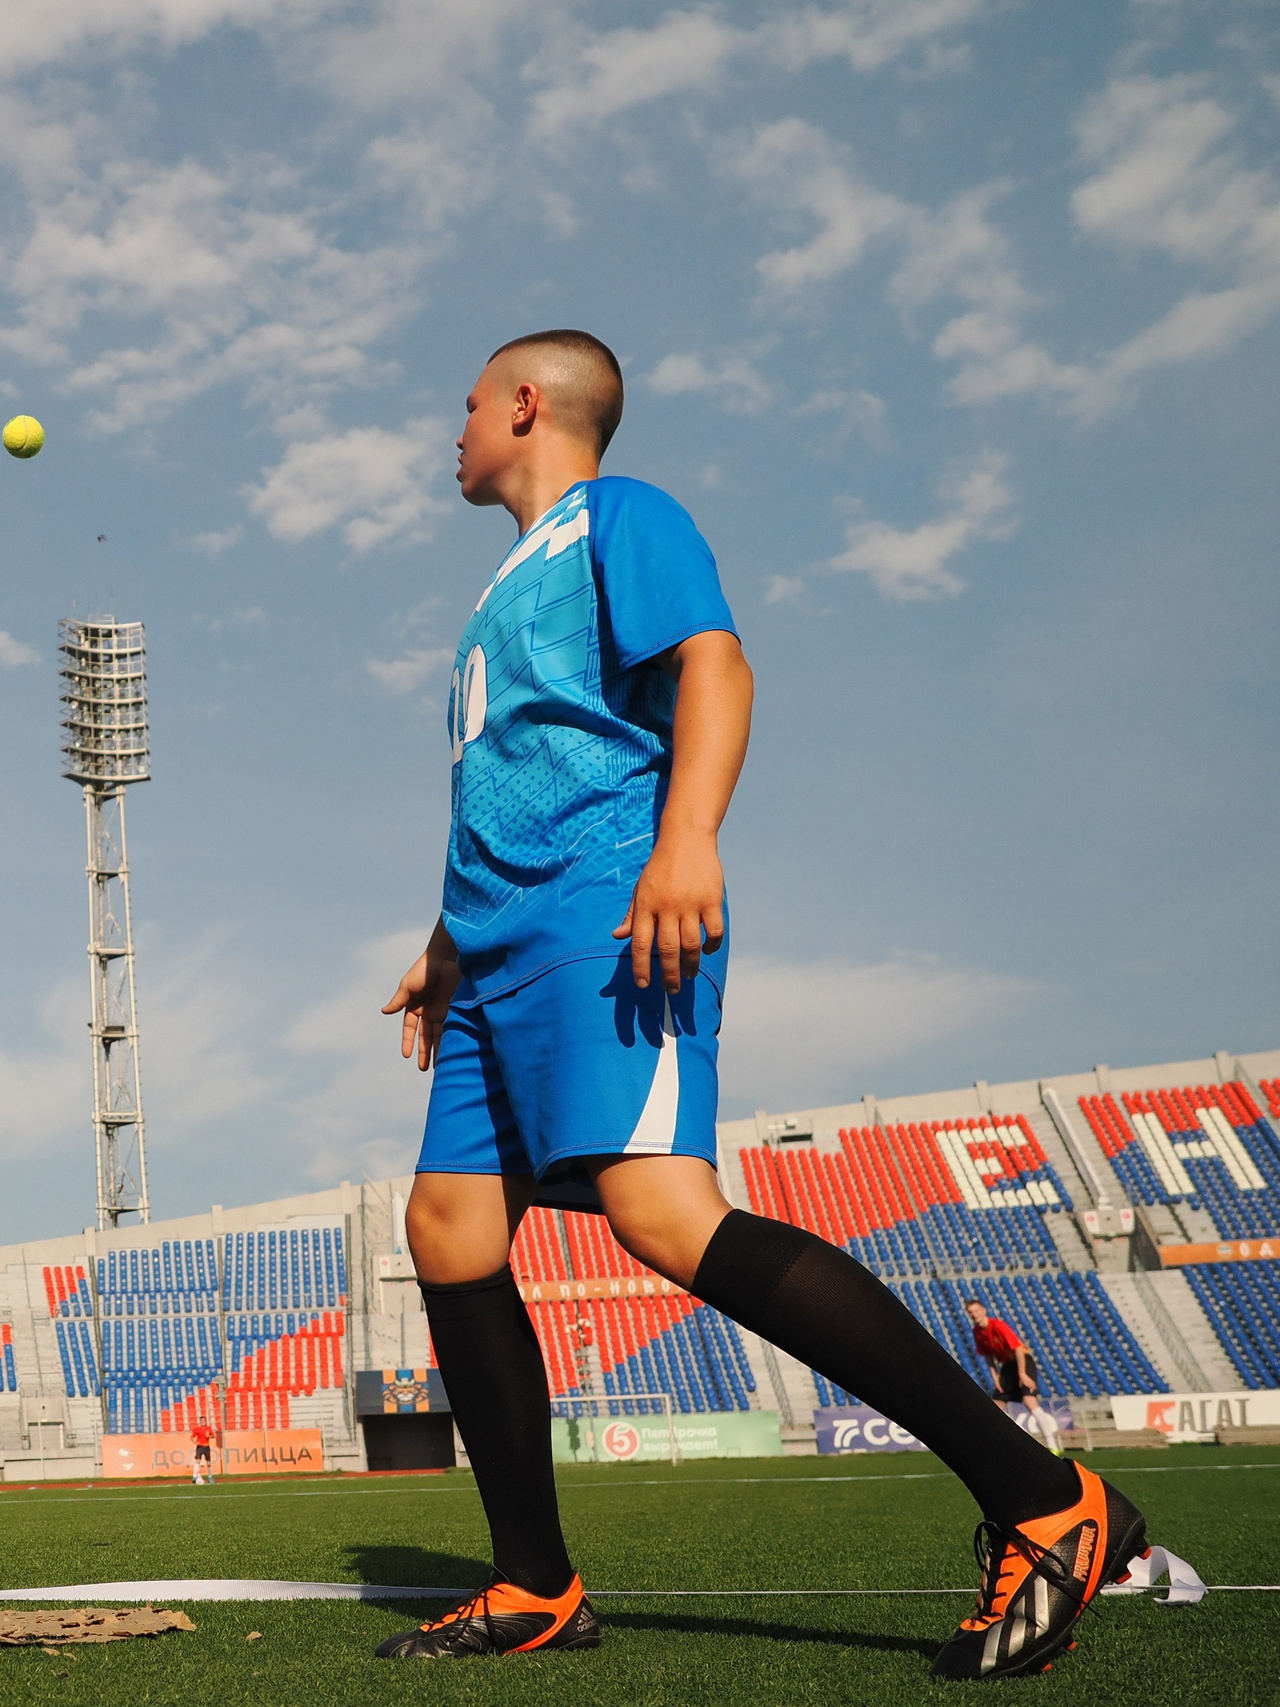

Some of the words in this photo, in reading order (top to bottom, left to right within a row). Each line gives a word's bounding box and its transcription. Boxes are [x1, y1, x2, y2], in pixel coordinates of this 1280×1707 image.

[451, 643, 488, 765] 10
[559, 1279, 682, 1298] ПО-НОВО
[642, 1438, 718, 1454] вырчает!
[226, 1446, 313, 1466] ПИЦЦА
